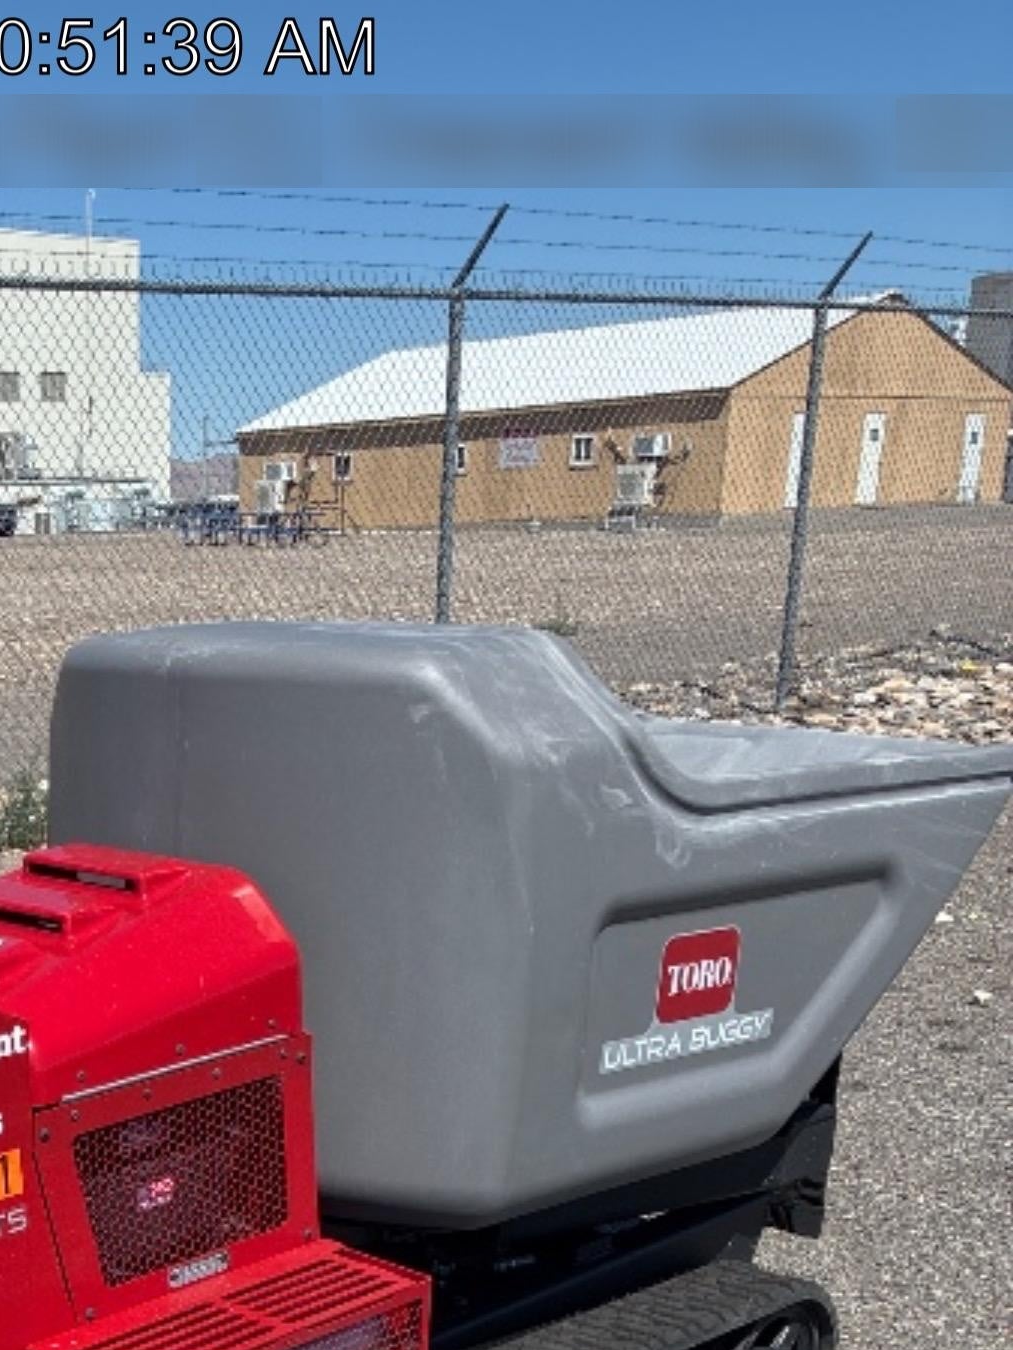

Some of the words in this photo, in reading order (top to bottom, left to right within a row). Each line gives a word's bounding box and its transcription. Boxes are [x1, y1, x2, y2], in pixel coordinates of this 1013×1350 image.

[668, 956, 732, 997] TORO
[602, 1032, 682, 1070] ULTRA
[690, 1010, 774, 1051] BUGGY
